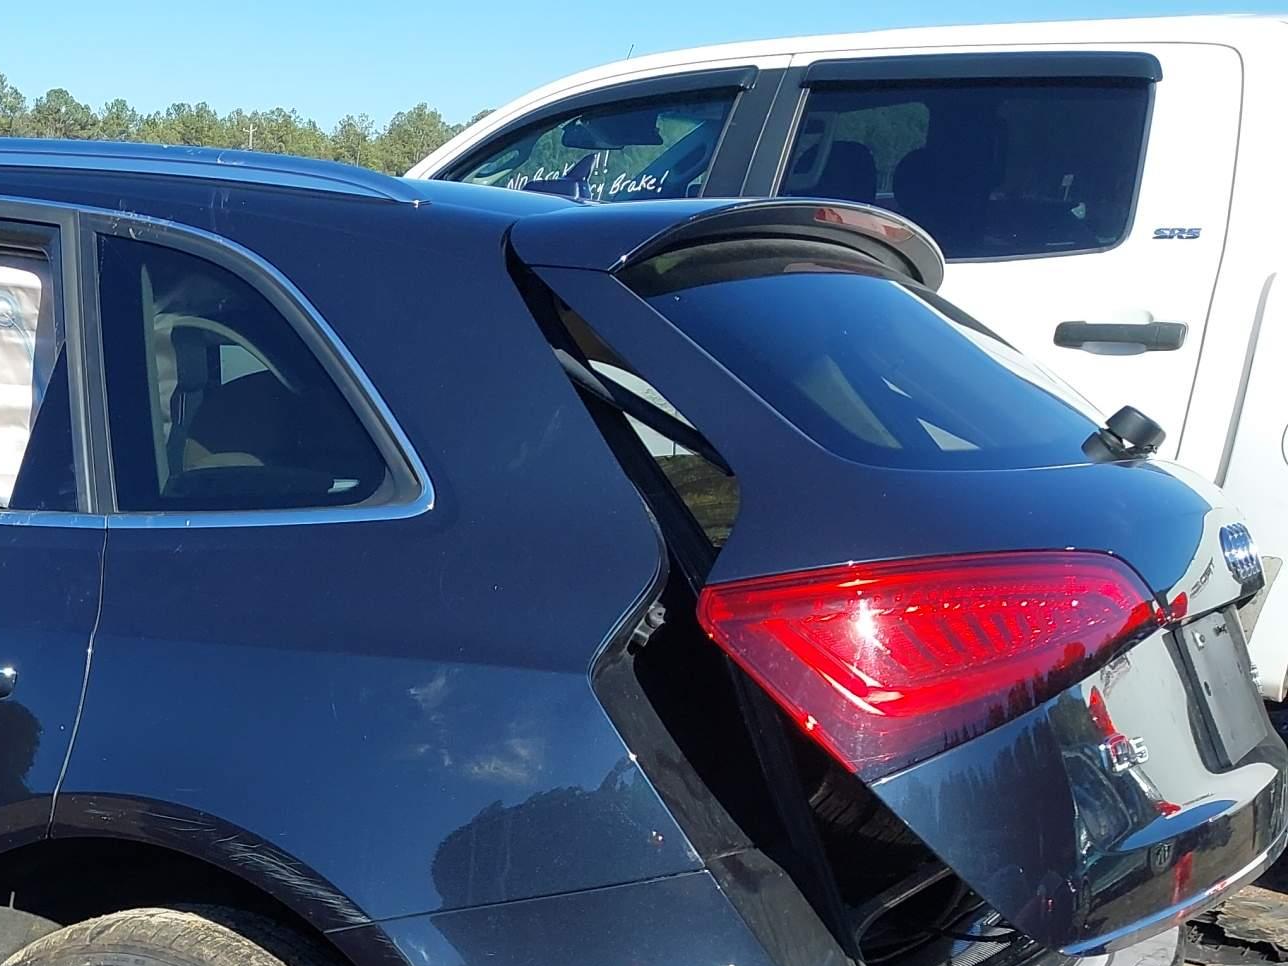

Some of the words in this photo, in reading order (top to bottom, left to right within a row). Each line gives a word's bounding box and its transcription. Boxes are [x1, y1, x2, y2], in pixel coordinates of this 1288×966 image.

[608, 170, 668, 195] Brake!
[1151, 227, 1202, 240] SR5
[1106, 733, 1149, 772] Q5
